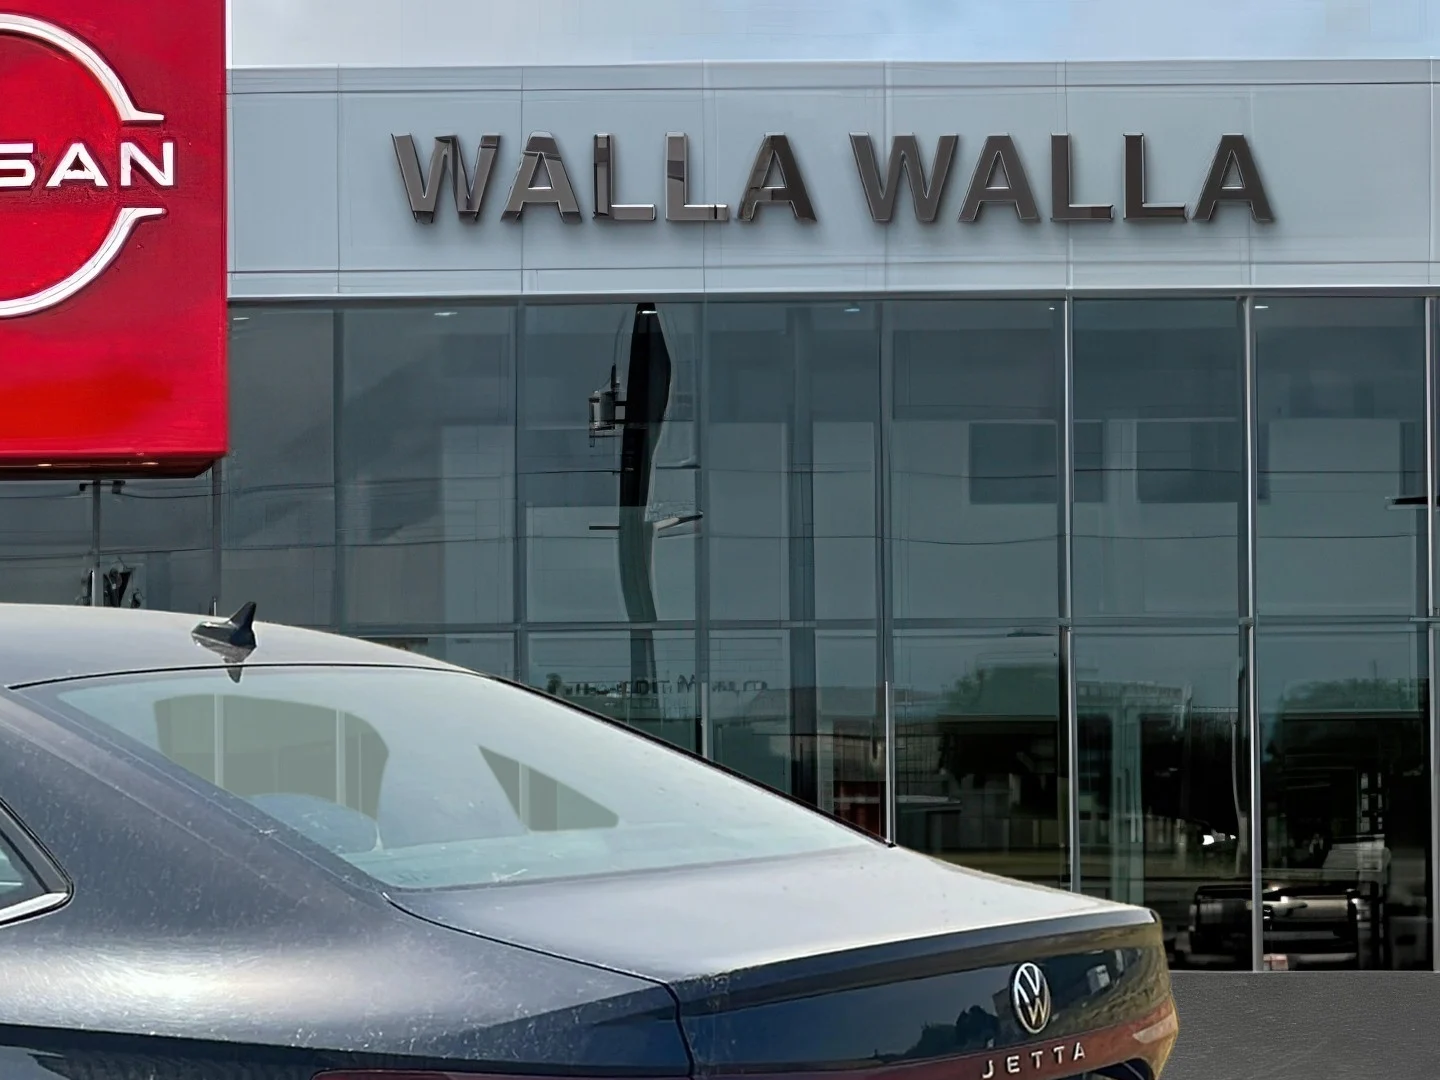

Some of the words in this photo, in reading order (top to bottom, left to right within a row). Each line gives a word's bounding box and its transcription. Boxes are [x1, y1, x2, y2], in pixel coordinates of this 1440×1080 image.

[391, 130, 818, 225] WALLA
[849, 132, 1274, 224] WALLA
[981, 1042, 1086, 1080] JETTA
